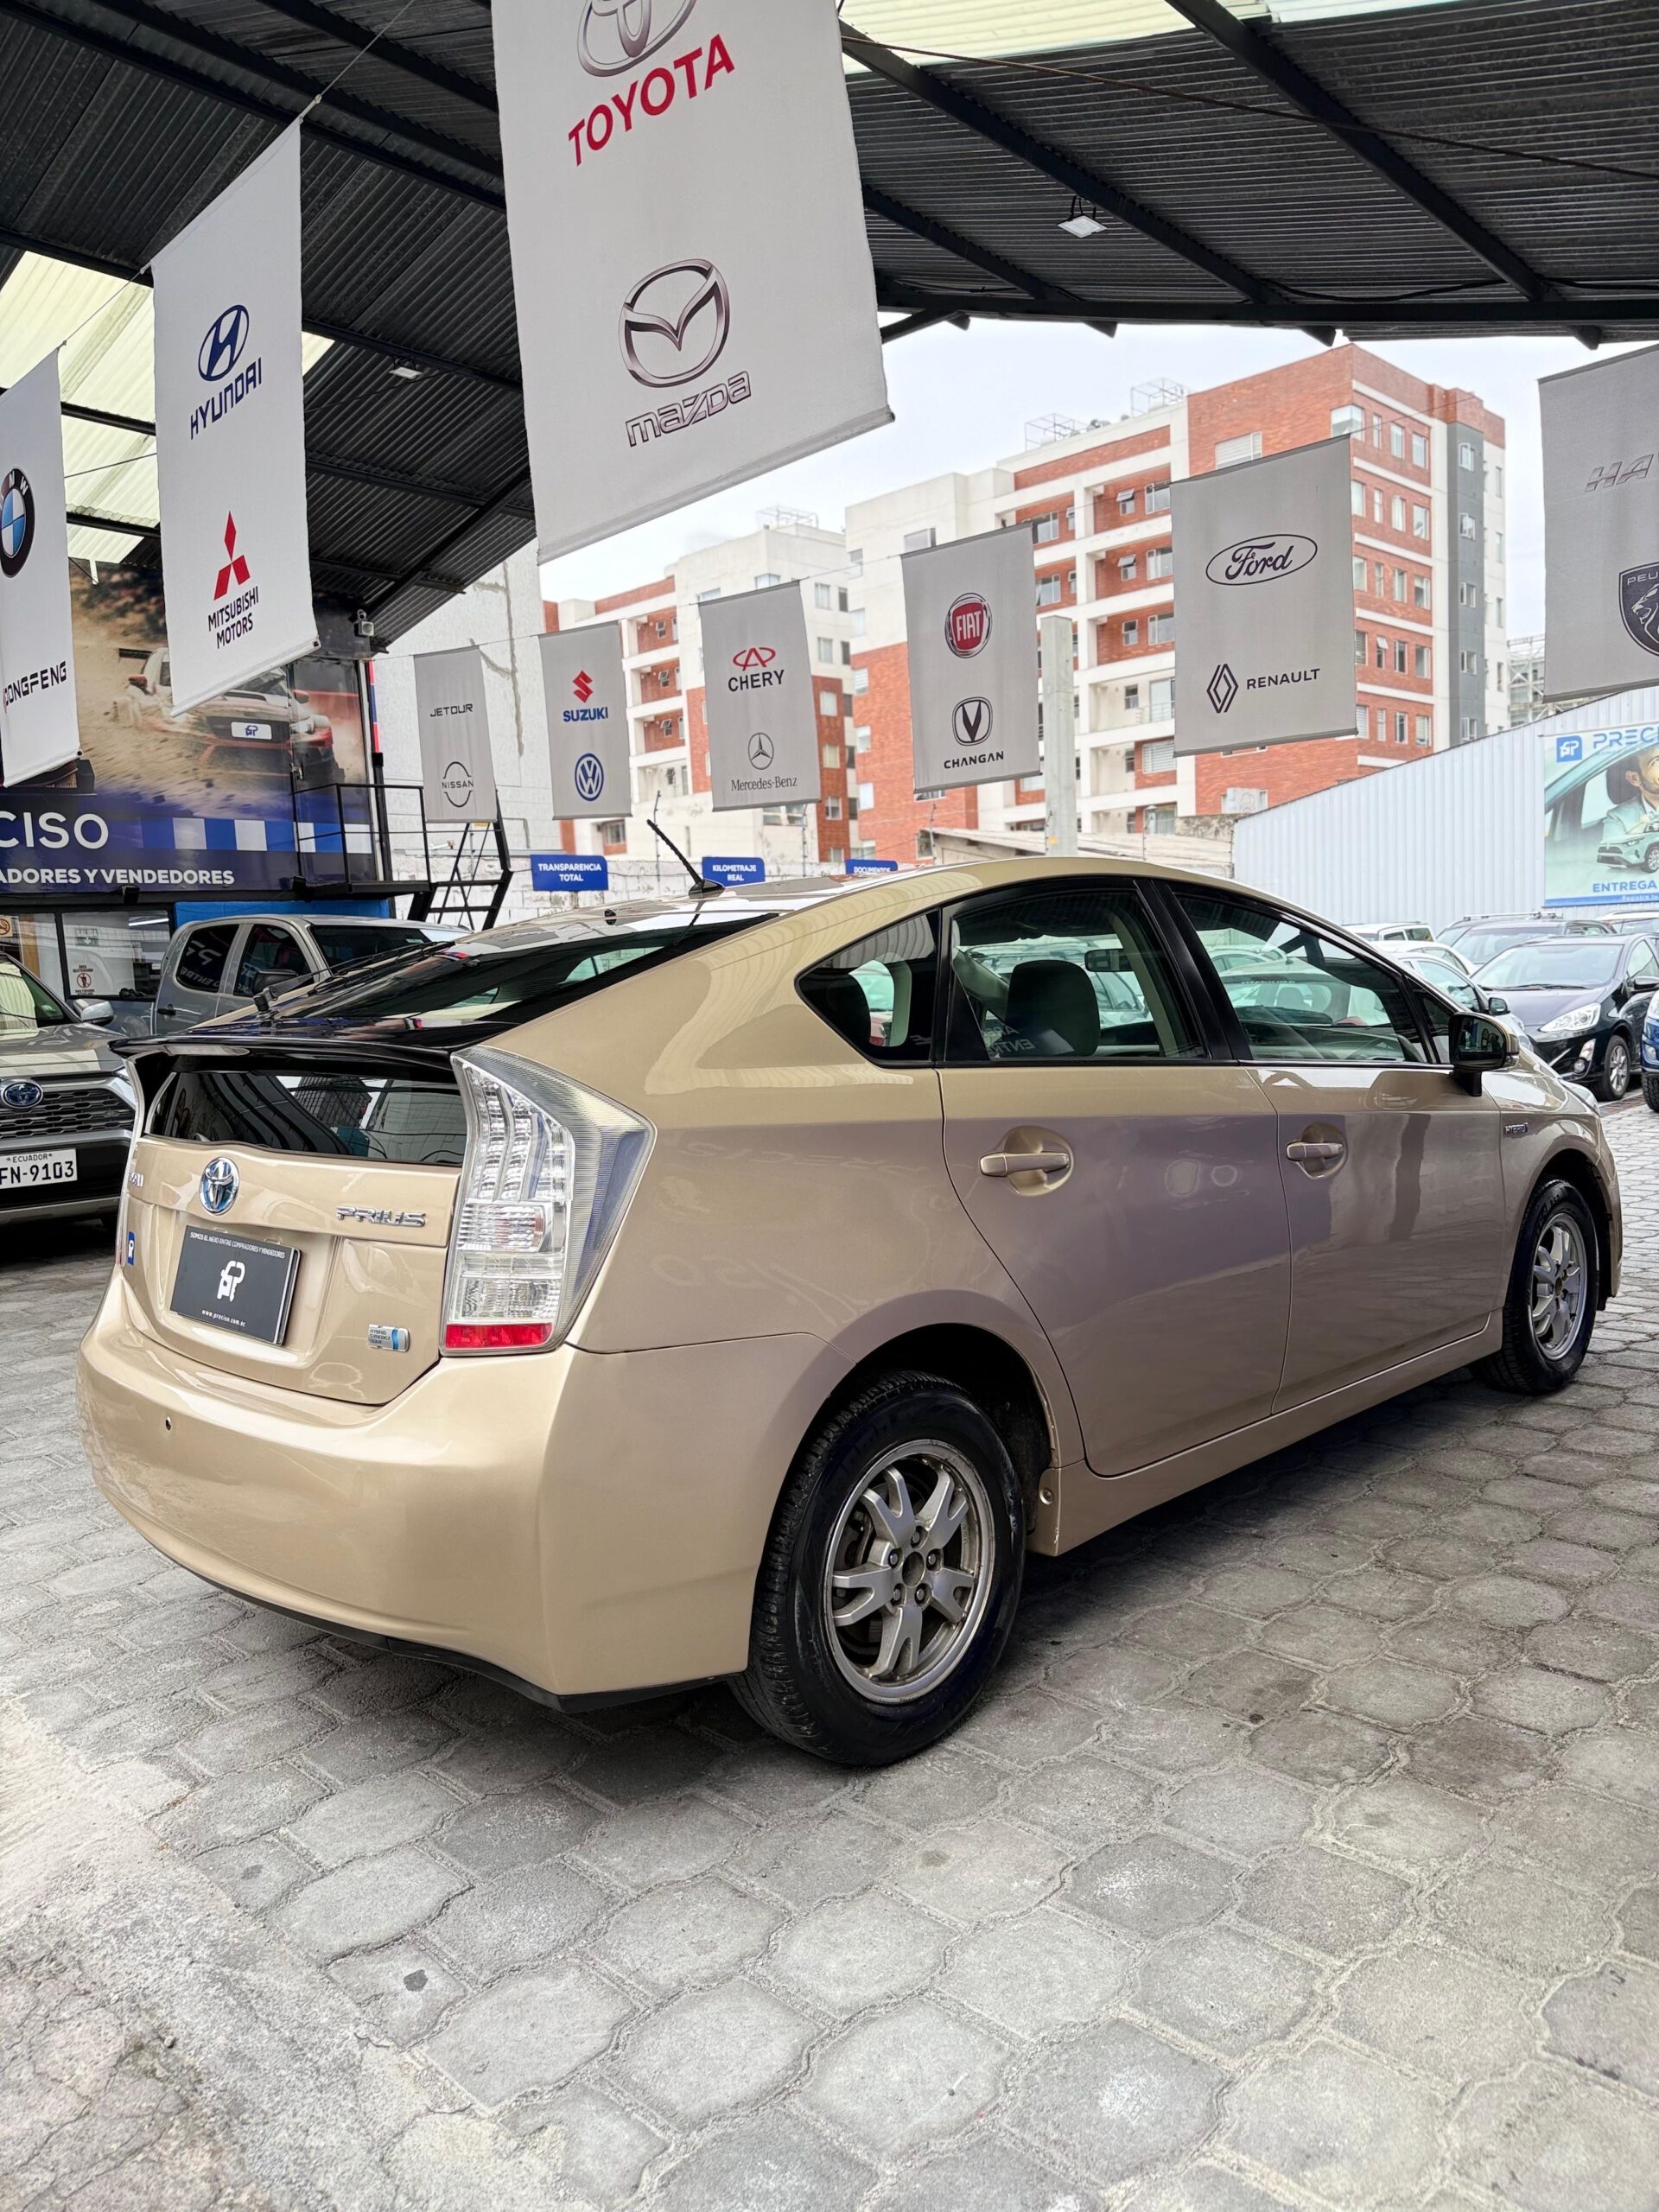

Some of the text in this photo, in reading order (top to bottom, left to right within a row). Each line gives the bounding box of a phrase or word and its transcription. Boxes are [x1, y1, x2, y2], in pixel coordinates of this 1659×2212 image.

[569, 34, 735, 167] TOYOTA
[190, 357, 262, 440] HYUNDAI
[1224, 542, 1294, 580] Ford
[1627, 571, 1658, 585] PEU
[207, 585, 259, 632] MITSUBISHI
[216, 612, 253, 649] MOTORS
[956, 610, 982, 641] FIAT
[728, 669, 785, 692] CHERY
[1246, 668, 1320, 690] RENAULT
[429, 703, 474, 717] JETOUR
[563, 706, 609, 722] SUZUKI
[1592, 727, 1659, 749] PREC
[944, 751, 1005, 769] CHANGAN
[442, 779, 474, 790] NISSAN
[729, 776, 798, 791] Mercedes-Benz
[537, 862, 602, 872] TRANSPARENCIA
[712, 864, 757, 873] KILOMETRAJE
[83, 868, 97, 884] Y
[99, 868, 235, 885] VENDEDORES
[558, 873, 584, 882] TOTAL
[1592, 880, 1657, 893] ENTREGA
[12, 1153, 48, 1163] ECUADOR
[336, 1205, 426, 1227] PRIUS
[189, 1231, 204, 1241] SOMOS
[219, 1238, 232, 1247] ENTRE
[232, 1241, 259, 1253] COMPRADORES
[261, 1248, 286, 1259] VENDEDORES
